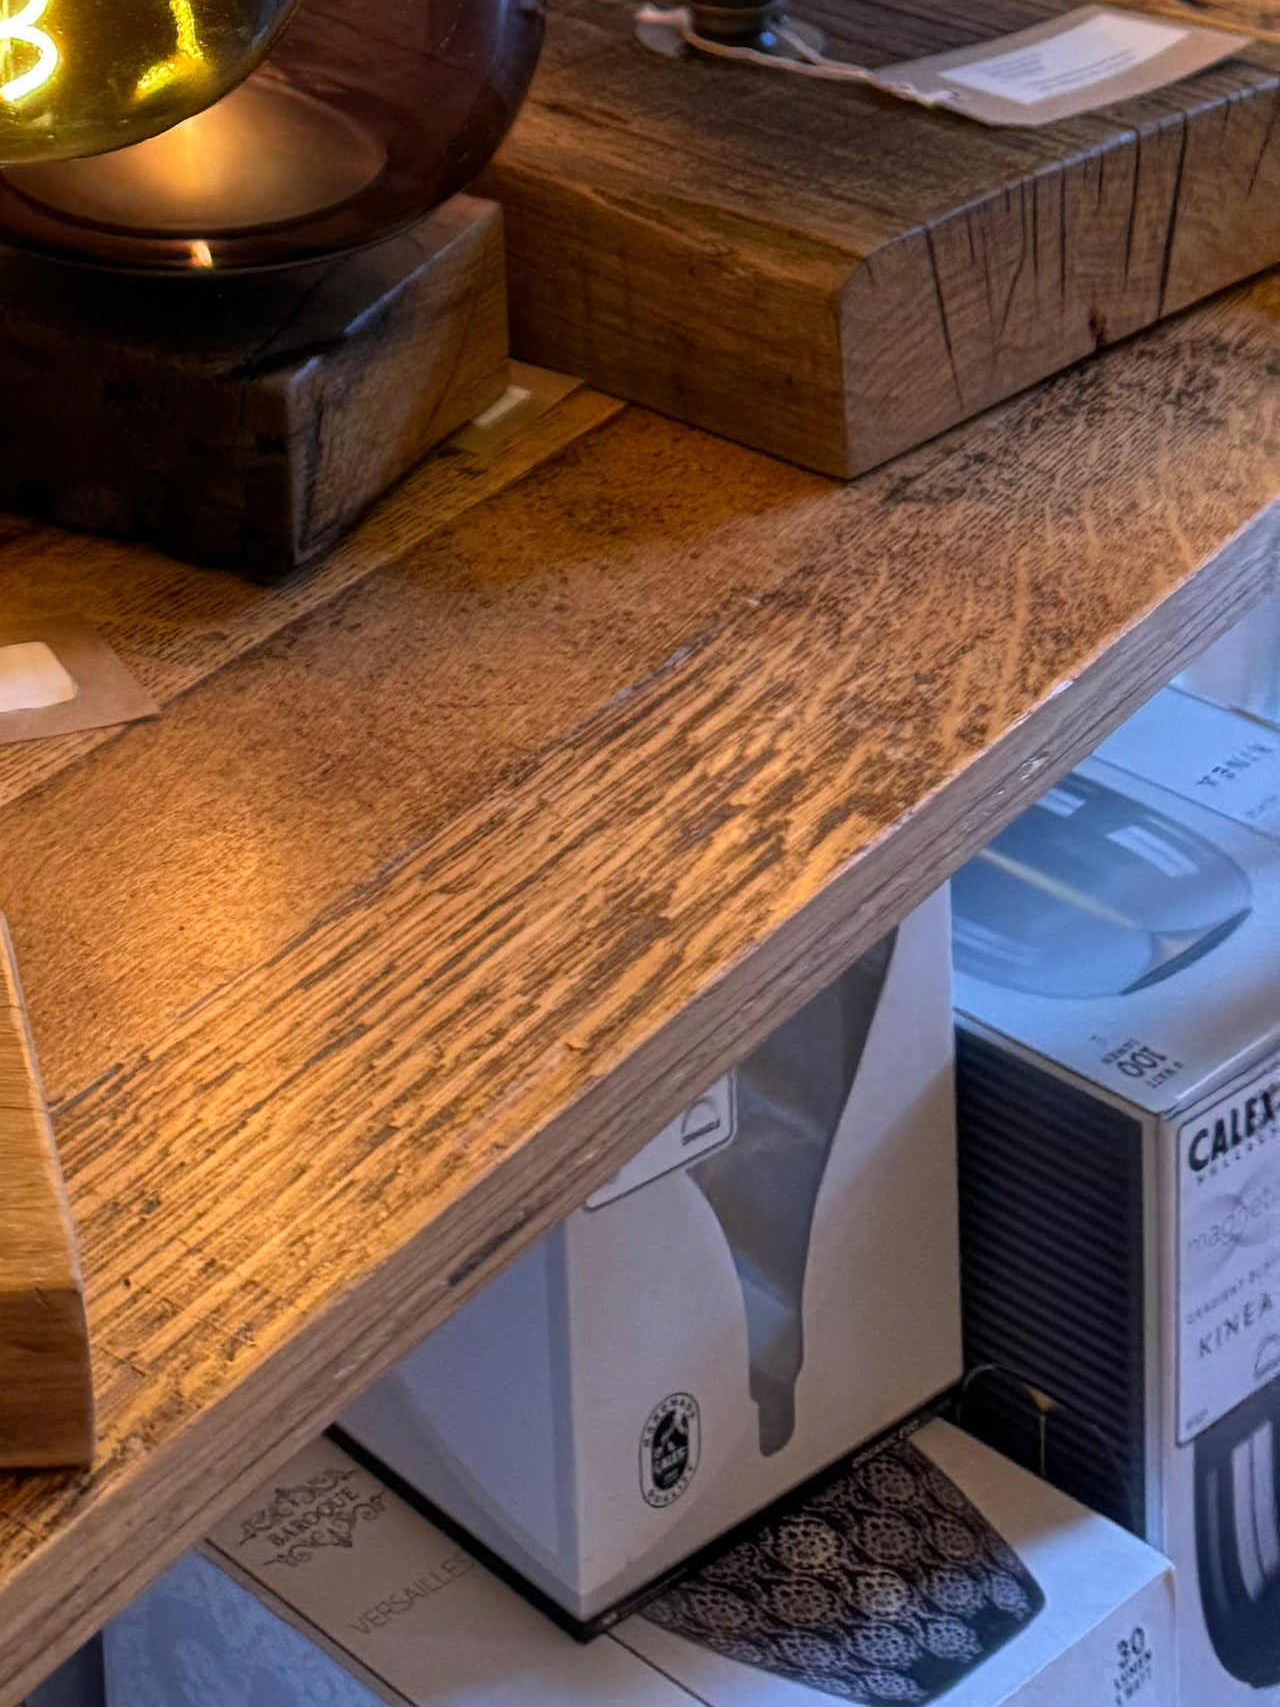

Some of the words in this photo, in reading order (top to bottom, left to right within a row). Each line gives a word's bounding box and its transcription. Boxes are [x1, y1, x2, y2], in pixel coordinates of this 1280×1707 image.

[1116, 1045, 1168, 1078] 100
[1188, 1082, 1280, 1172] CALEX
[267, 1487, 359, 1547] BAROQUE
[348, 1550, 476, 1636] VERSAILLES
